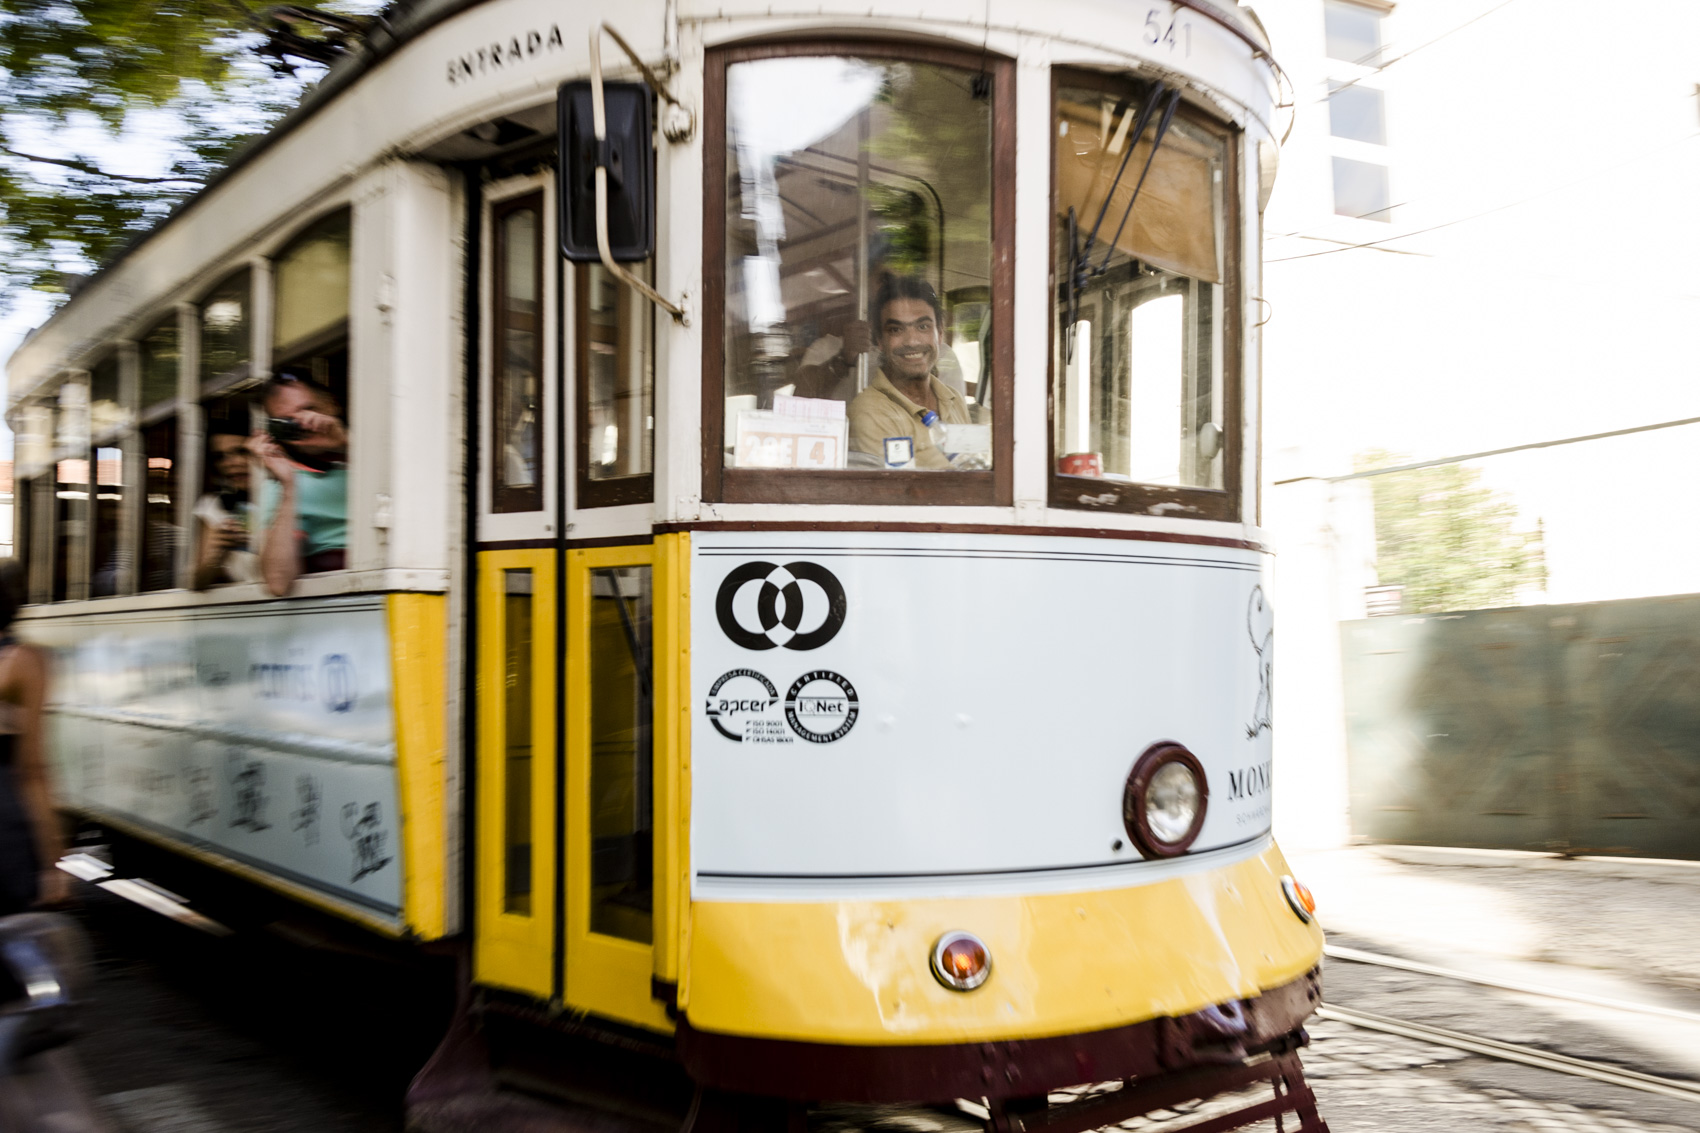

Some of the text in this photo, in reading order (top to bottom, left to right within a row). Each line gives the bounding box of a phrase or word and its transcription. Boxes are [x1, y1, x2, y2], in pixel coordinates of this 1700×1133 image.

[1143, 8, 1192, 59] 541
[446, 22, 565, 86] ENTRADA
[809, 441, 826, 465] 4
[790, 671, 855, 697] CERTIFIED
[719, 699, 767, 717] apcer
[799, 699, 845, 717] IQNet
